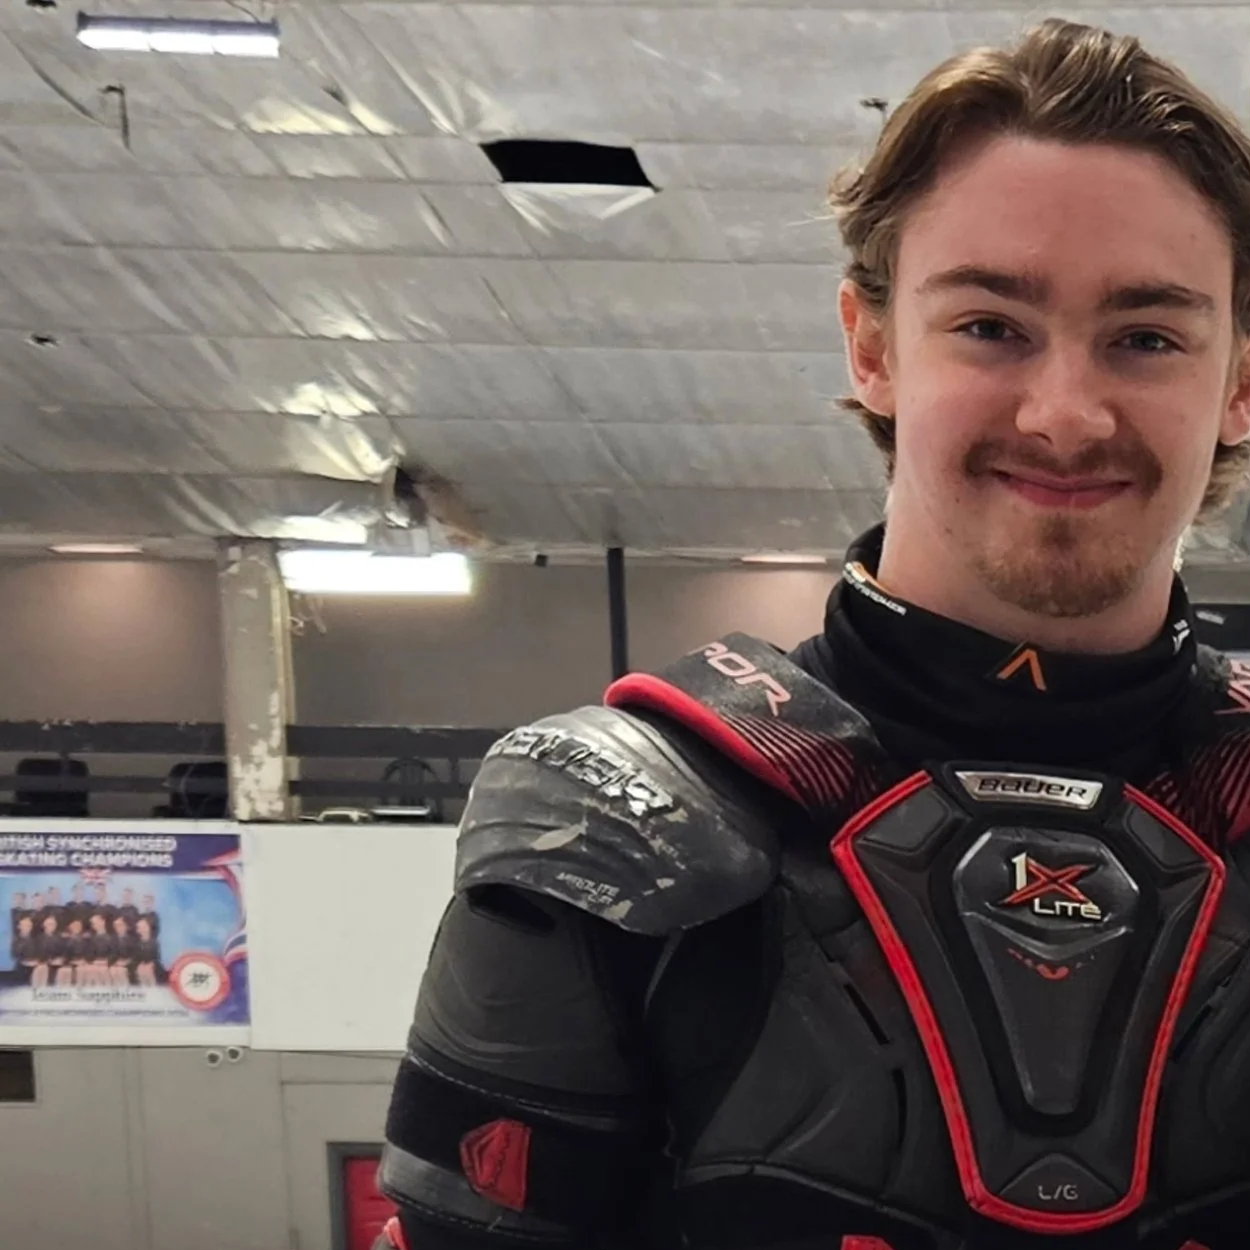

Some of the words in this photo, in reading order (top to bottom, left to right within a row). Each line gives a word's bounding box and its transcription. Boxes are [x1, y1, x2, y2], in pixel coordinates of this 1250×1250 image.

[978, 778, 1088, 800] BAUER
[70, 852, 173, 867] CHAMPIONS
[1034, 897, 1102, 920] LITE
[1038, 1184, 1079, 1201] L/G
